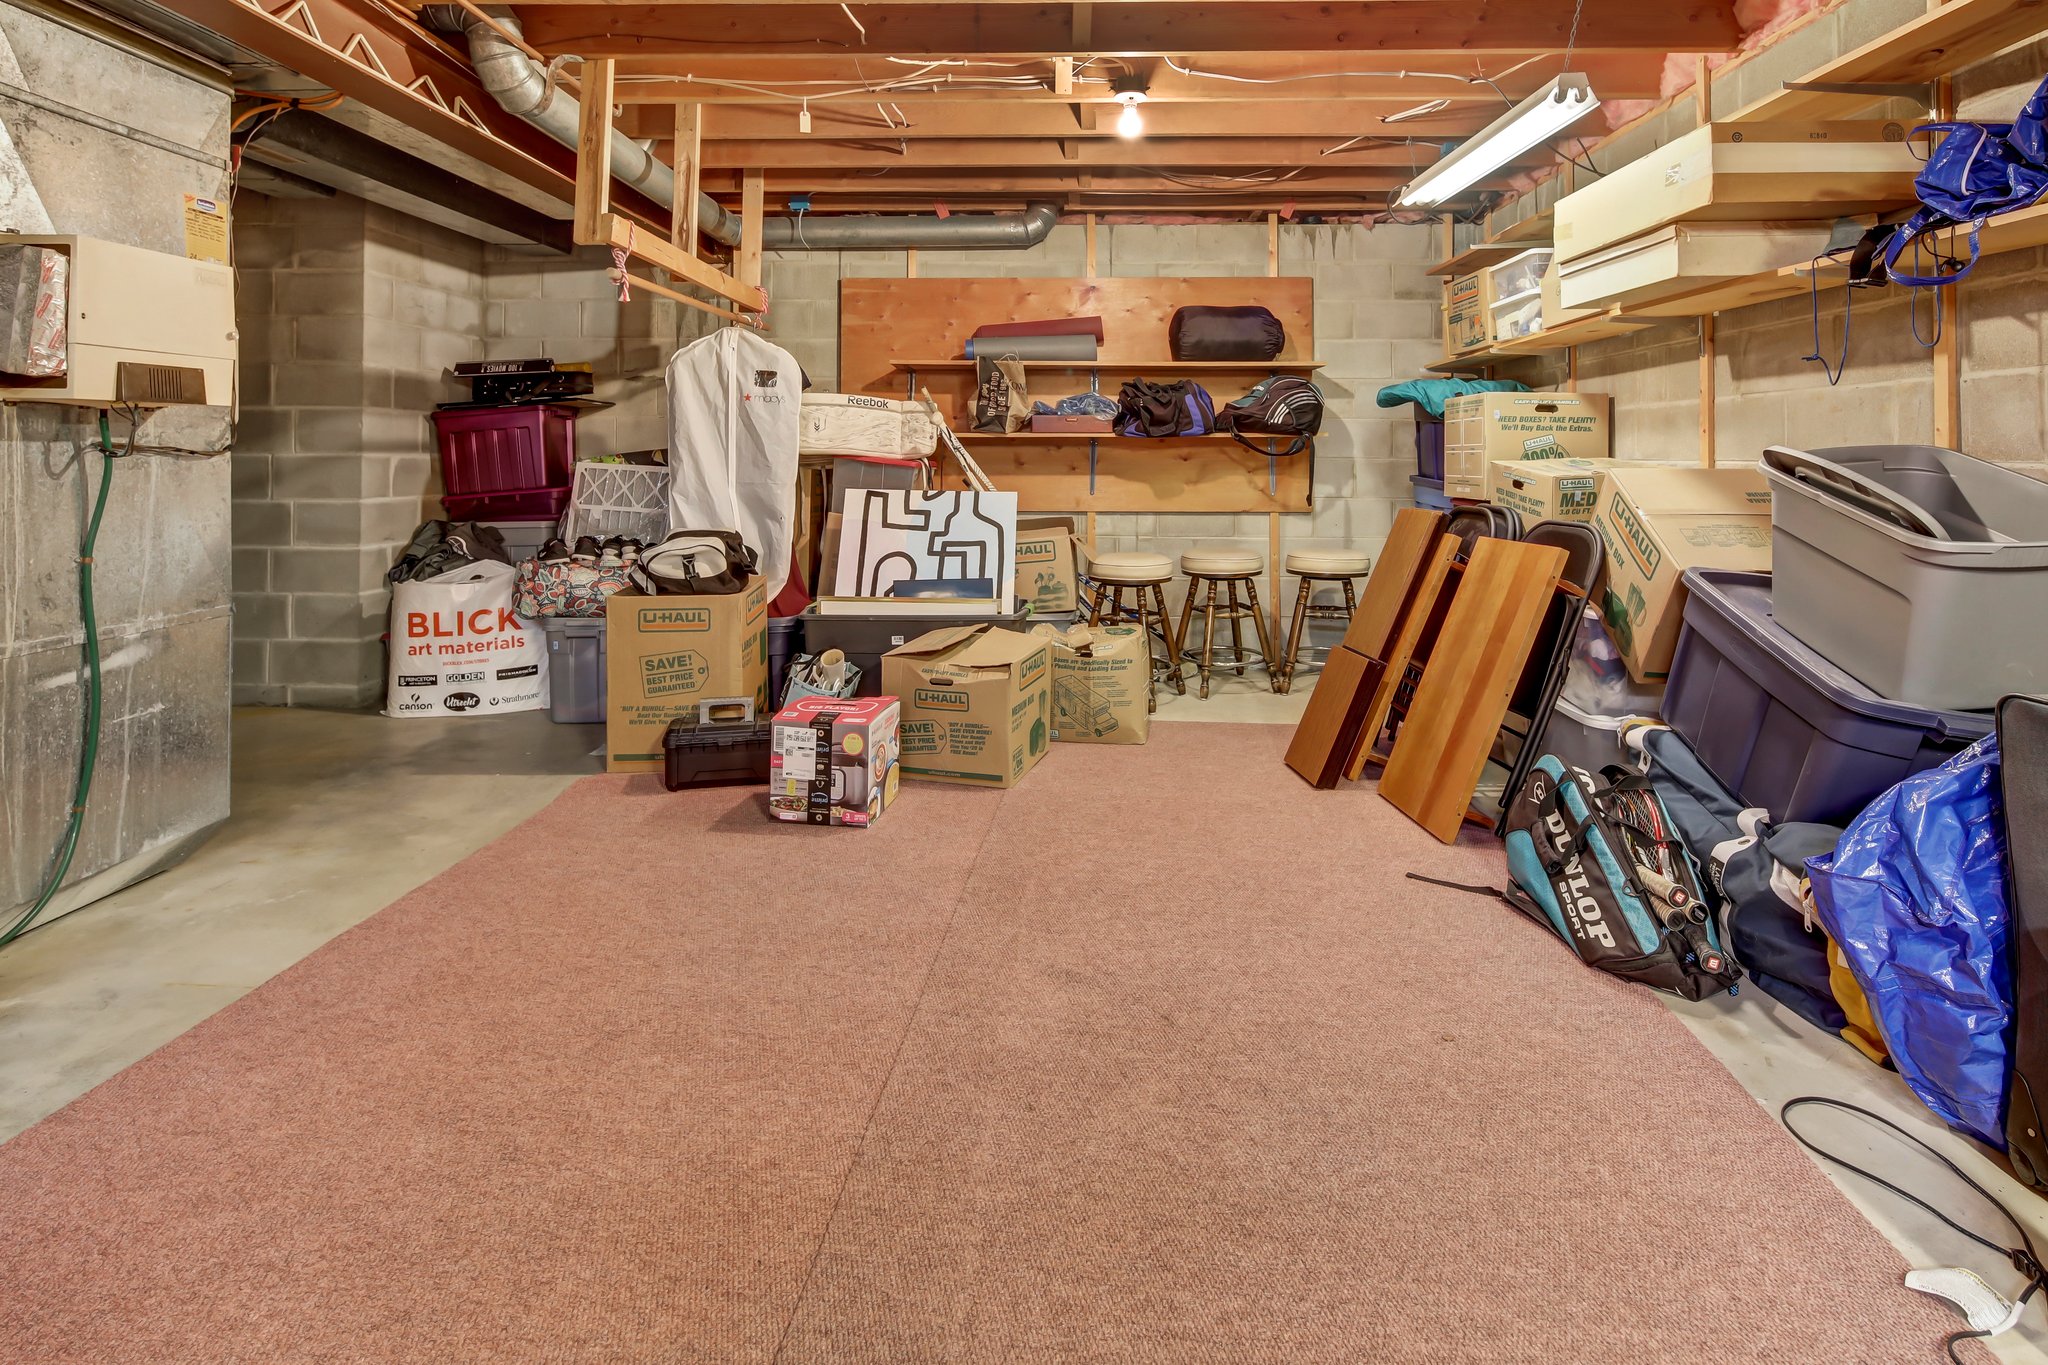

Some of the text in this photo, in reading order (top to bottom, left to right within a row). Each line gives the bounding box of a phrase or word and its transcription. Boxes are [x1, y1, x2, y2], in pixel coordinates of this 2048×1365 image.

[1453, 280, 1476, 296] U-HAUL
[848, 396, 889, 408] Reebok
[1525, 435, 1553, 448] U-HAUL
[1560, 492, 1598, 508] MED
[1614, 499, 1654, 567] U-HAUL
[1594, 514, 1625, 570] MEDIUM BOX
[1016, 544, 1052, 556] HAUL
[408, 607, 523, 638] BLICK
[642, 612, 706, 624] U-HAUL
[408, 635, 525, 656] art materials
[644, 654, 693, 672] SAVE!
[1022, 655, 1045, 678] U-HAUL
[446, 672, 486, 683] GOLDEN
[646, 671, 694, 686] BEST PRICE
[446, 696, 479, 708] Utrecht
[502, 692, 540, 704] Strathmore
[918, 692, 966, 704] U-HAUL
[900, 722, 934, 734] SAVE!
[1545, 809, 1616, 948] DUNLOP
[1558, 882, 1586, 940] SPORT
